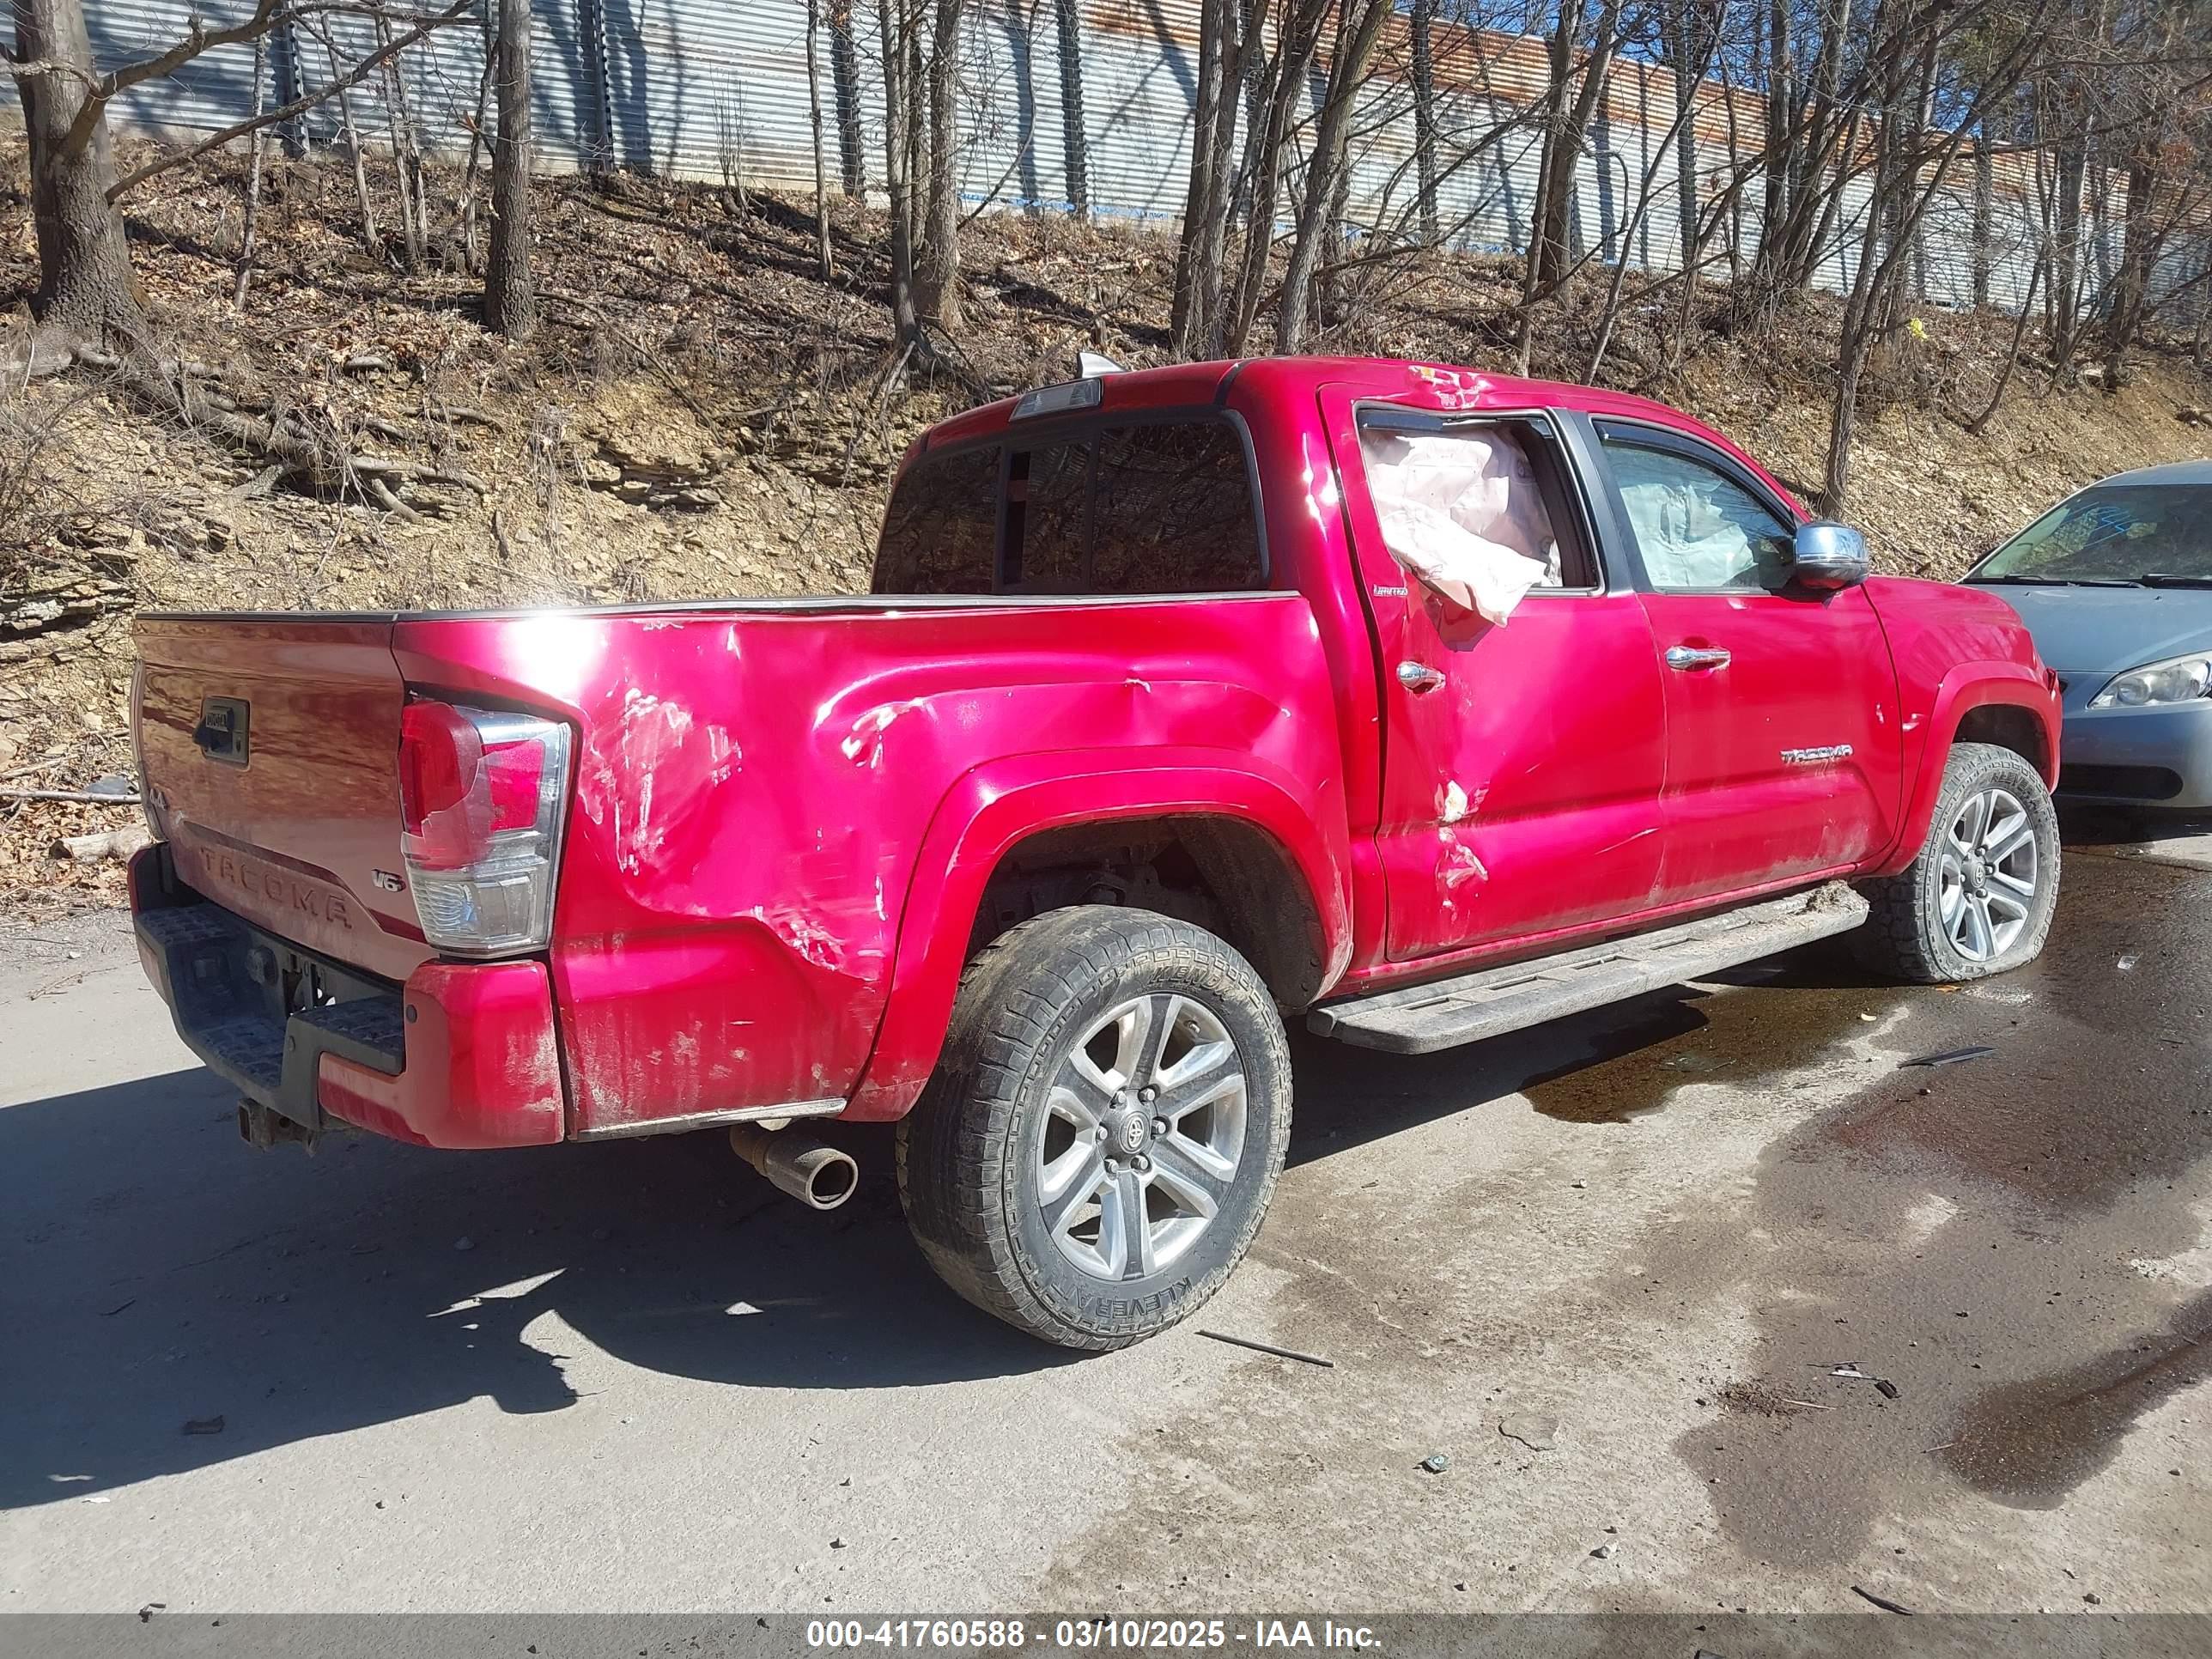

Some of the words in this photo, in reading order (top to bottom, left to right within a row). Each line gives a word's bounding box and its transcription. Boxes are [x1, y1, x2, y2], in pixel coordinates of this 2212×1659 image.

[1780, 744, 1854, 765] TACOMA
[199, 847, 353, 930] TACOMA
[371, 868, 406, 893] V6
[1095, 1276, 1193, 1320] KLEVER
